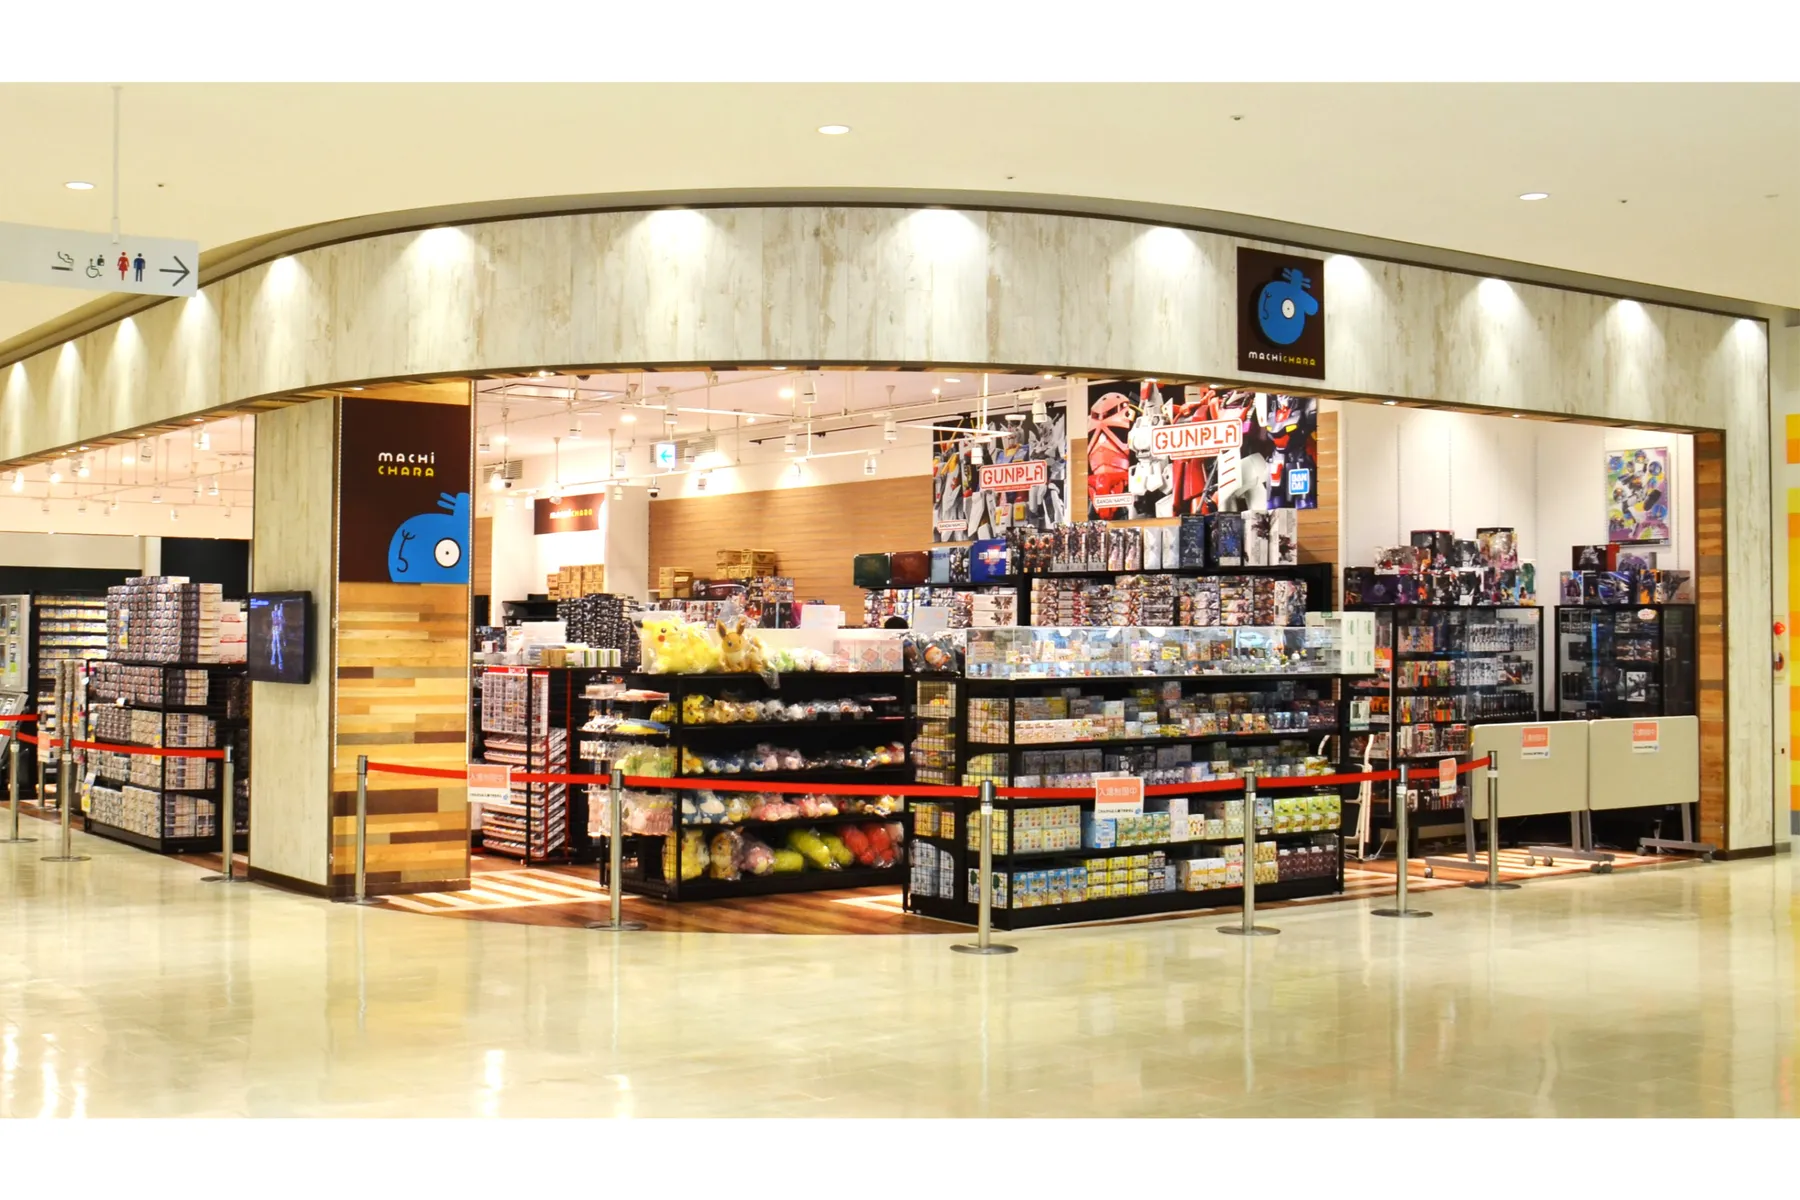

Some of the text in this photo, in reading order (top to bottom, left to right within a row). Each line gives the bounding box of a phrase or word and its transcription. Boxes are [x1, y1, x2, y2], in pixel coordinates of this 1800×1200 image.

[1155, 424, 1237, 450] GUNPLA
[378, 465, 434, 477] CHARA
[983, 464, 1043, 485] GUNPLA
